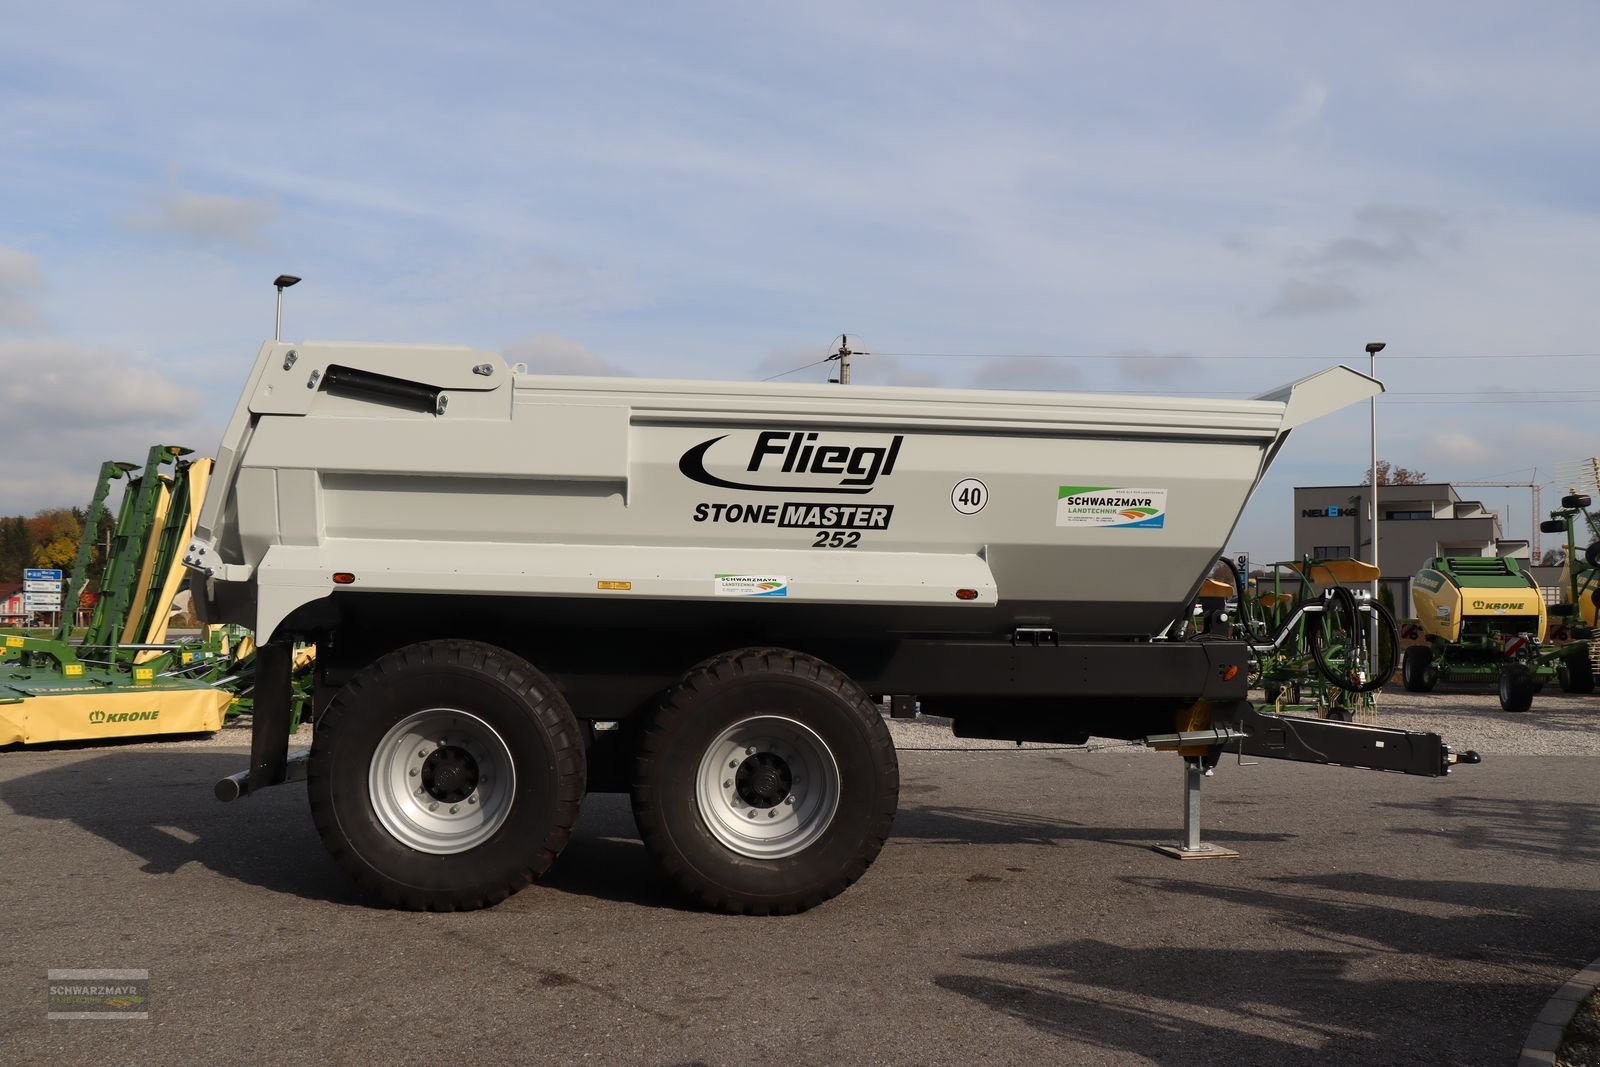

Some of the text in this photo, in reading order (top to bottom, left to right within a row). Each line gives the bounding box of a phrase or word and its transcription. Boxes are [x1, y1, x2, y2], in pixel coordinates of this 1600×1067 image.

[747, 431, 904, 485] Fliegl
[958, 487, 981, 506] 40
[1067, 496, 1152, 507] SCHWARZMAYR
[693, 503, 888, 527] STONE MASTER
[1067, 507, 1117, 515] LANDTECHNIK
[812, 531, 861, 549] 252
[106, 710, 160, 723] KRONE
